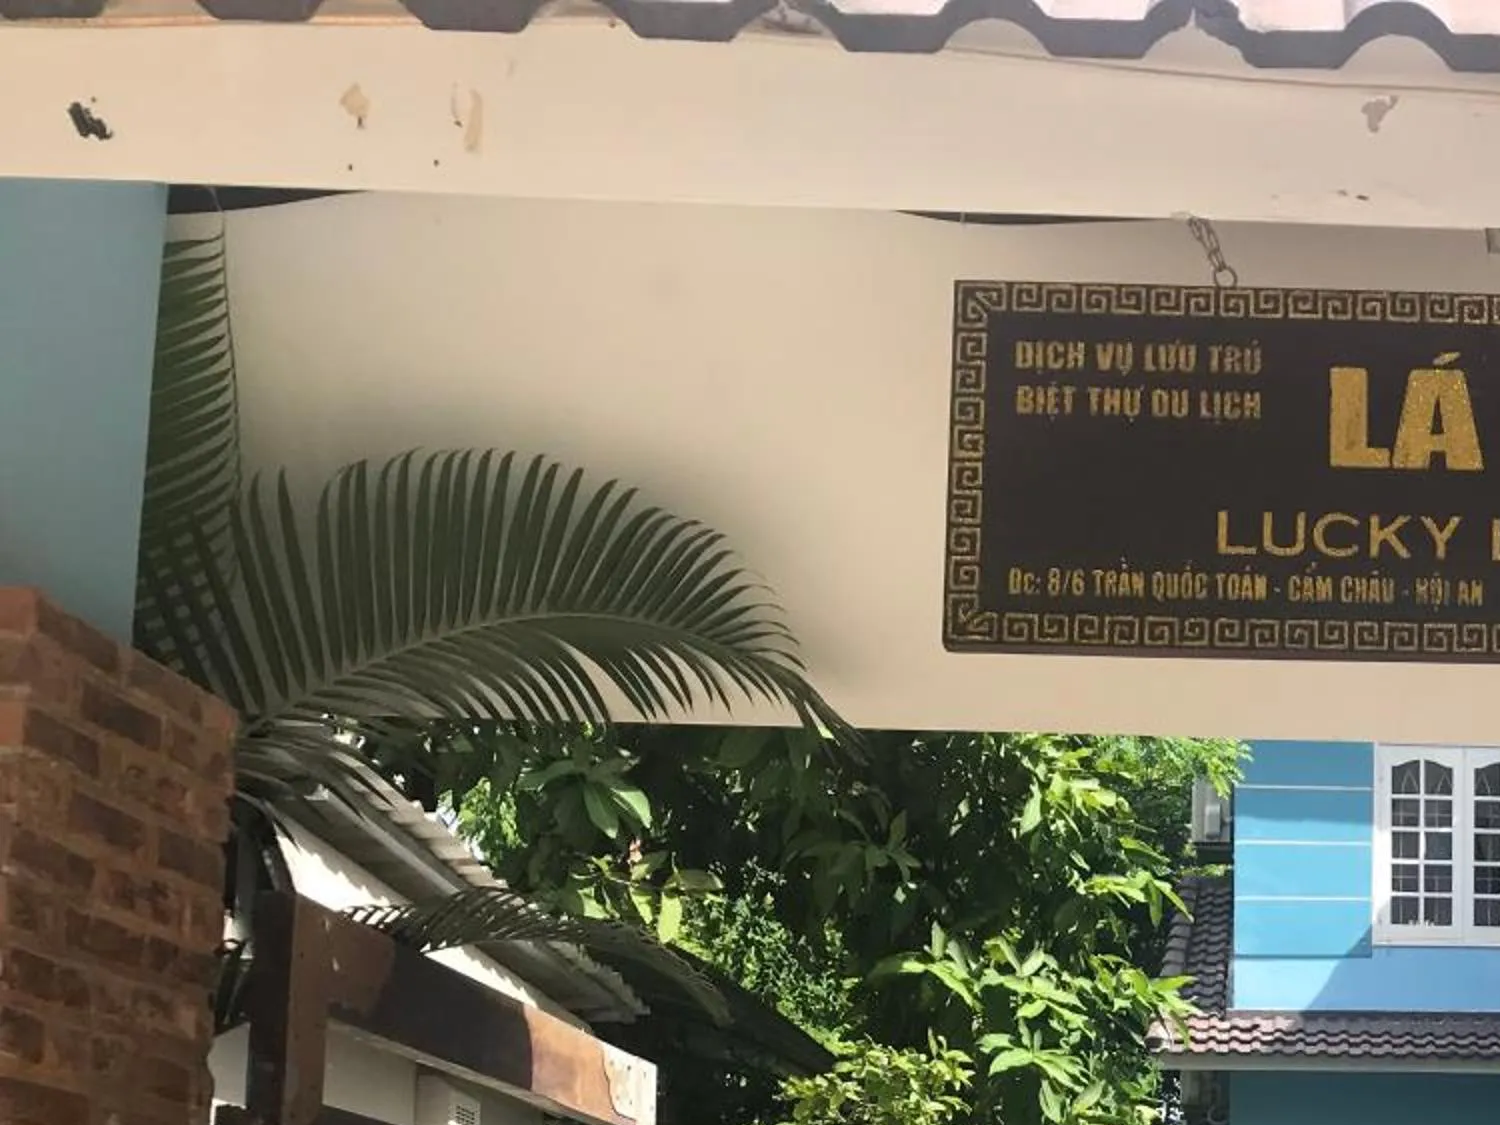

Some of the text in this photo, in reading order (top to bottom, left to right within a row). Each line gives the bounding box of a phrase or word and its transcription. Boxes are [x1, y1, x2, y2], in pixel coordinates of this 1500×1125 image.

[1330, 351, 1484, 471] LÁ
[1217, 510, 1461, 559] LUCKY
[1048, 567, 1085, 596] 8/6
